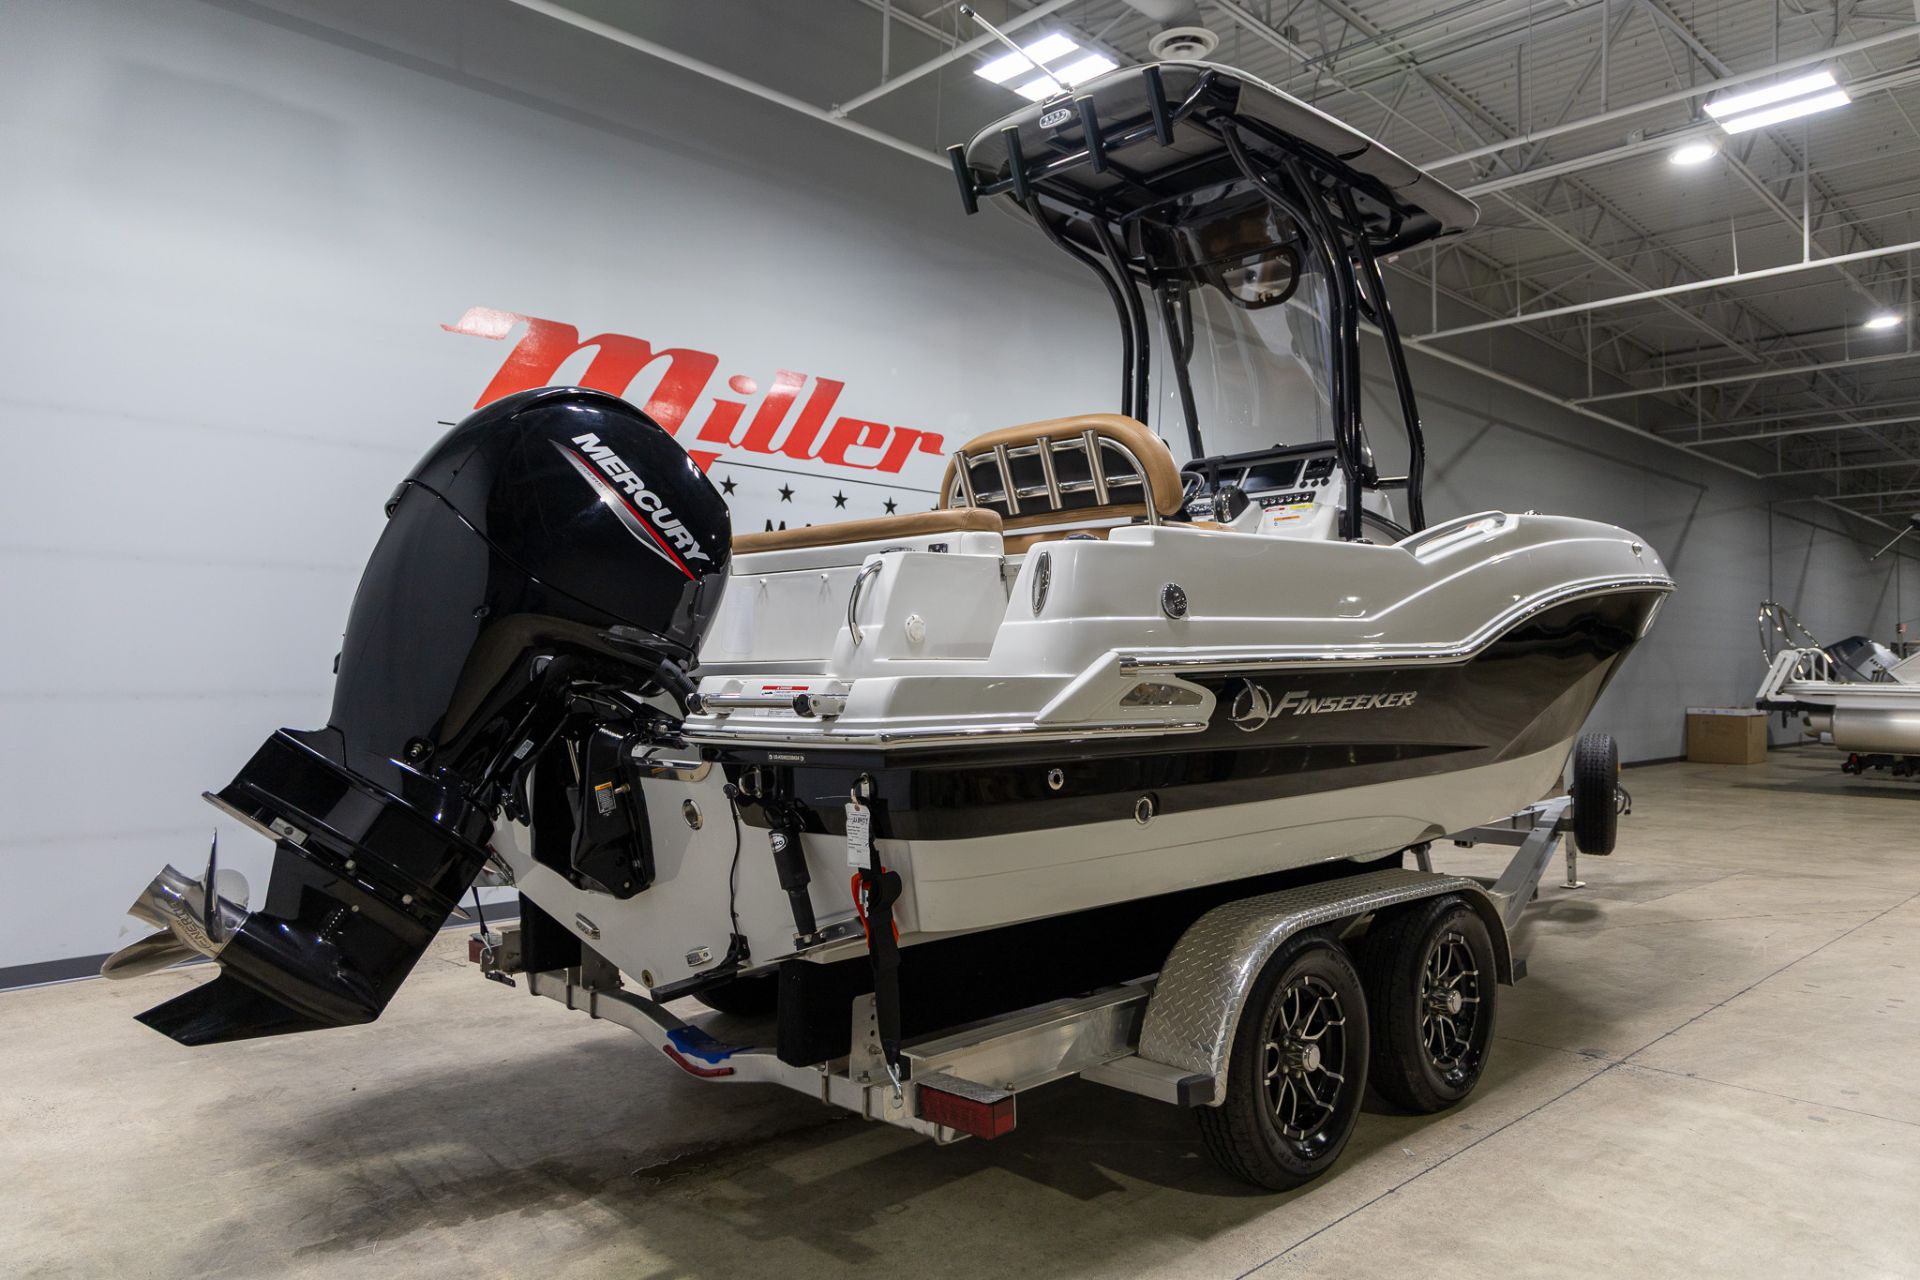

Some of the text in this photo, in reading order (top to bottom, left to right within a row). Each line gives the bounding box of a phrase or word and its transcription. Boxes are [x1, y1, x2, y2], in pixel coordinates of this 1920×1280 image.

[441, 306, 945, 474] Miller
[571, 432, 711, 561] MERCURY
[1268, 690, 1417, 718] FINSEEKER
